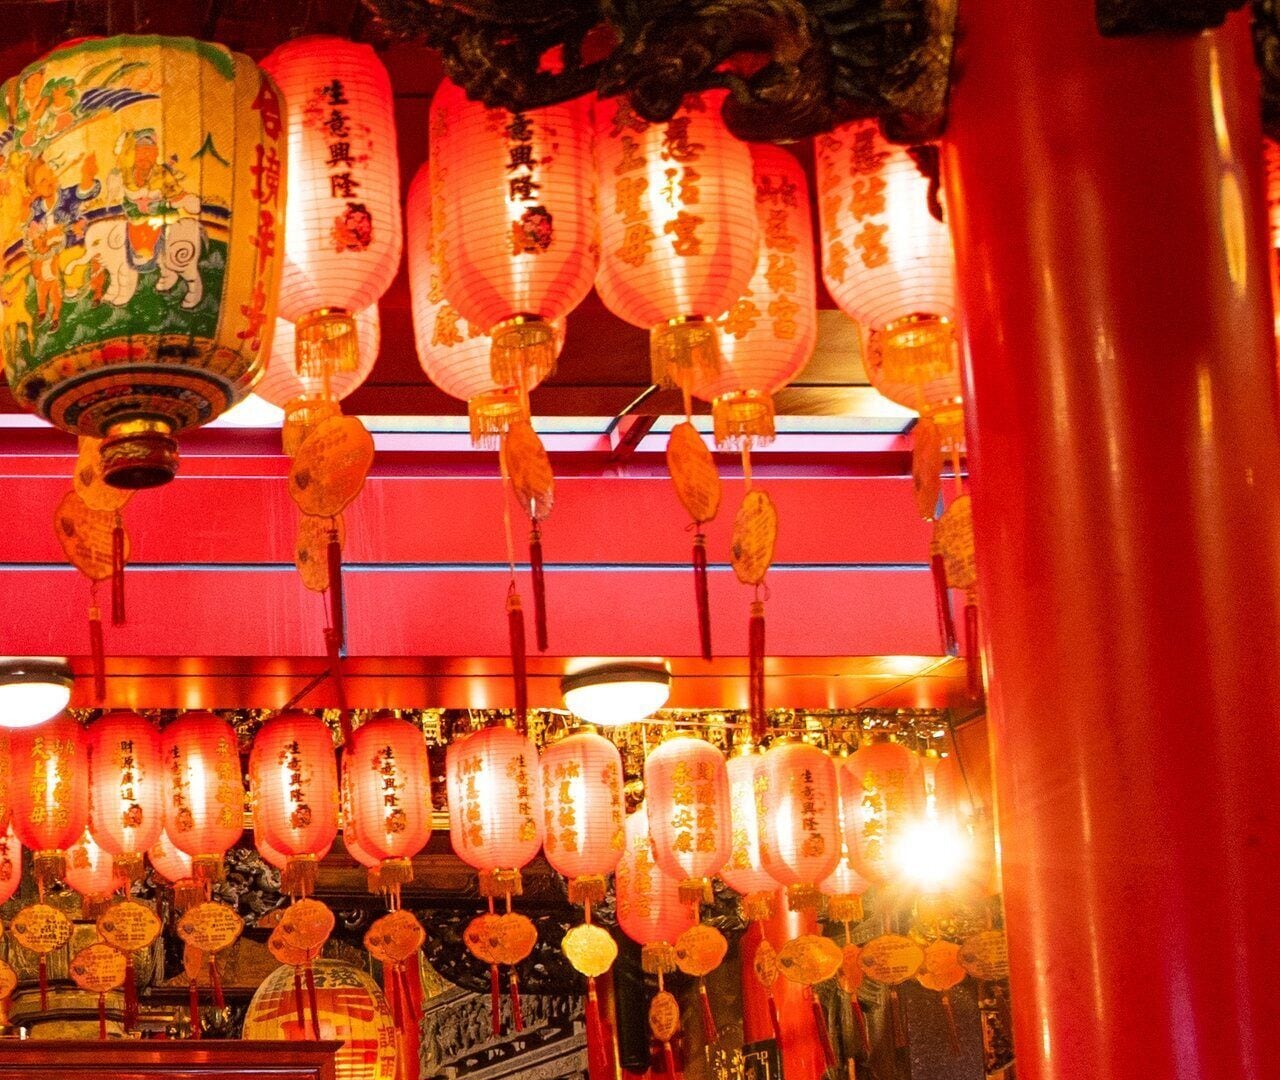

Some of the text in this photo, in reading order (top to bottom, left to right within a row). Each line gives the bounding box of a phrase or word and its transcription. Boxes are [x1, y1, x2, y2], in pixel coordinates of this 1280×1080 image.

[320, 80, 360, 198] 生意興隆
[119, 740, 137, 801] 財源廣進
[288, 741, 306, 803] 生意興隆
[381, 746, 399, 808] 生意興隆
